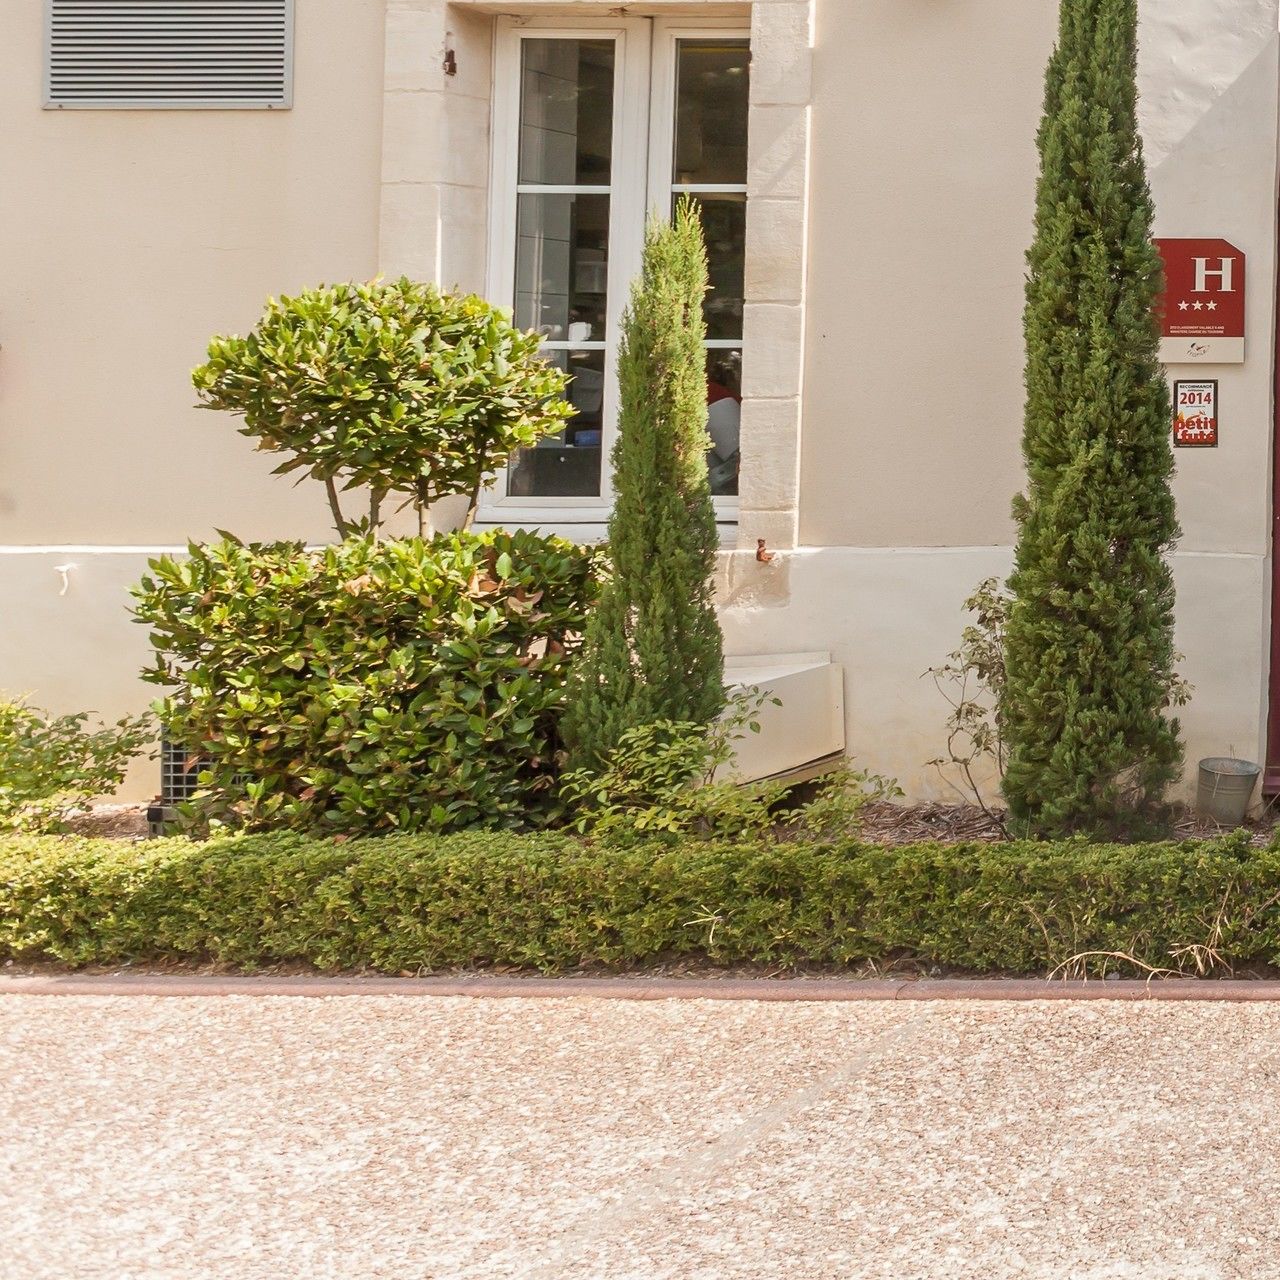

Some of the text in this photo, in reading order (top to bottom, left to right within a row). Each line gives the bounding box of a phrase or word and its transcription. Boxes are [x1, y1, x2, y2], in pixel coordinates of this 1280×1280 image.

[1190, 257, 1236, 292] H
[1180, 392, 1212, 405] 2014
[1174, 417, 1217, 433] petit
